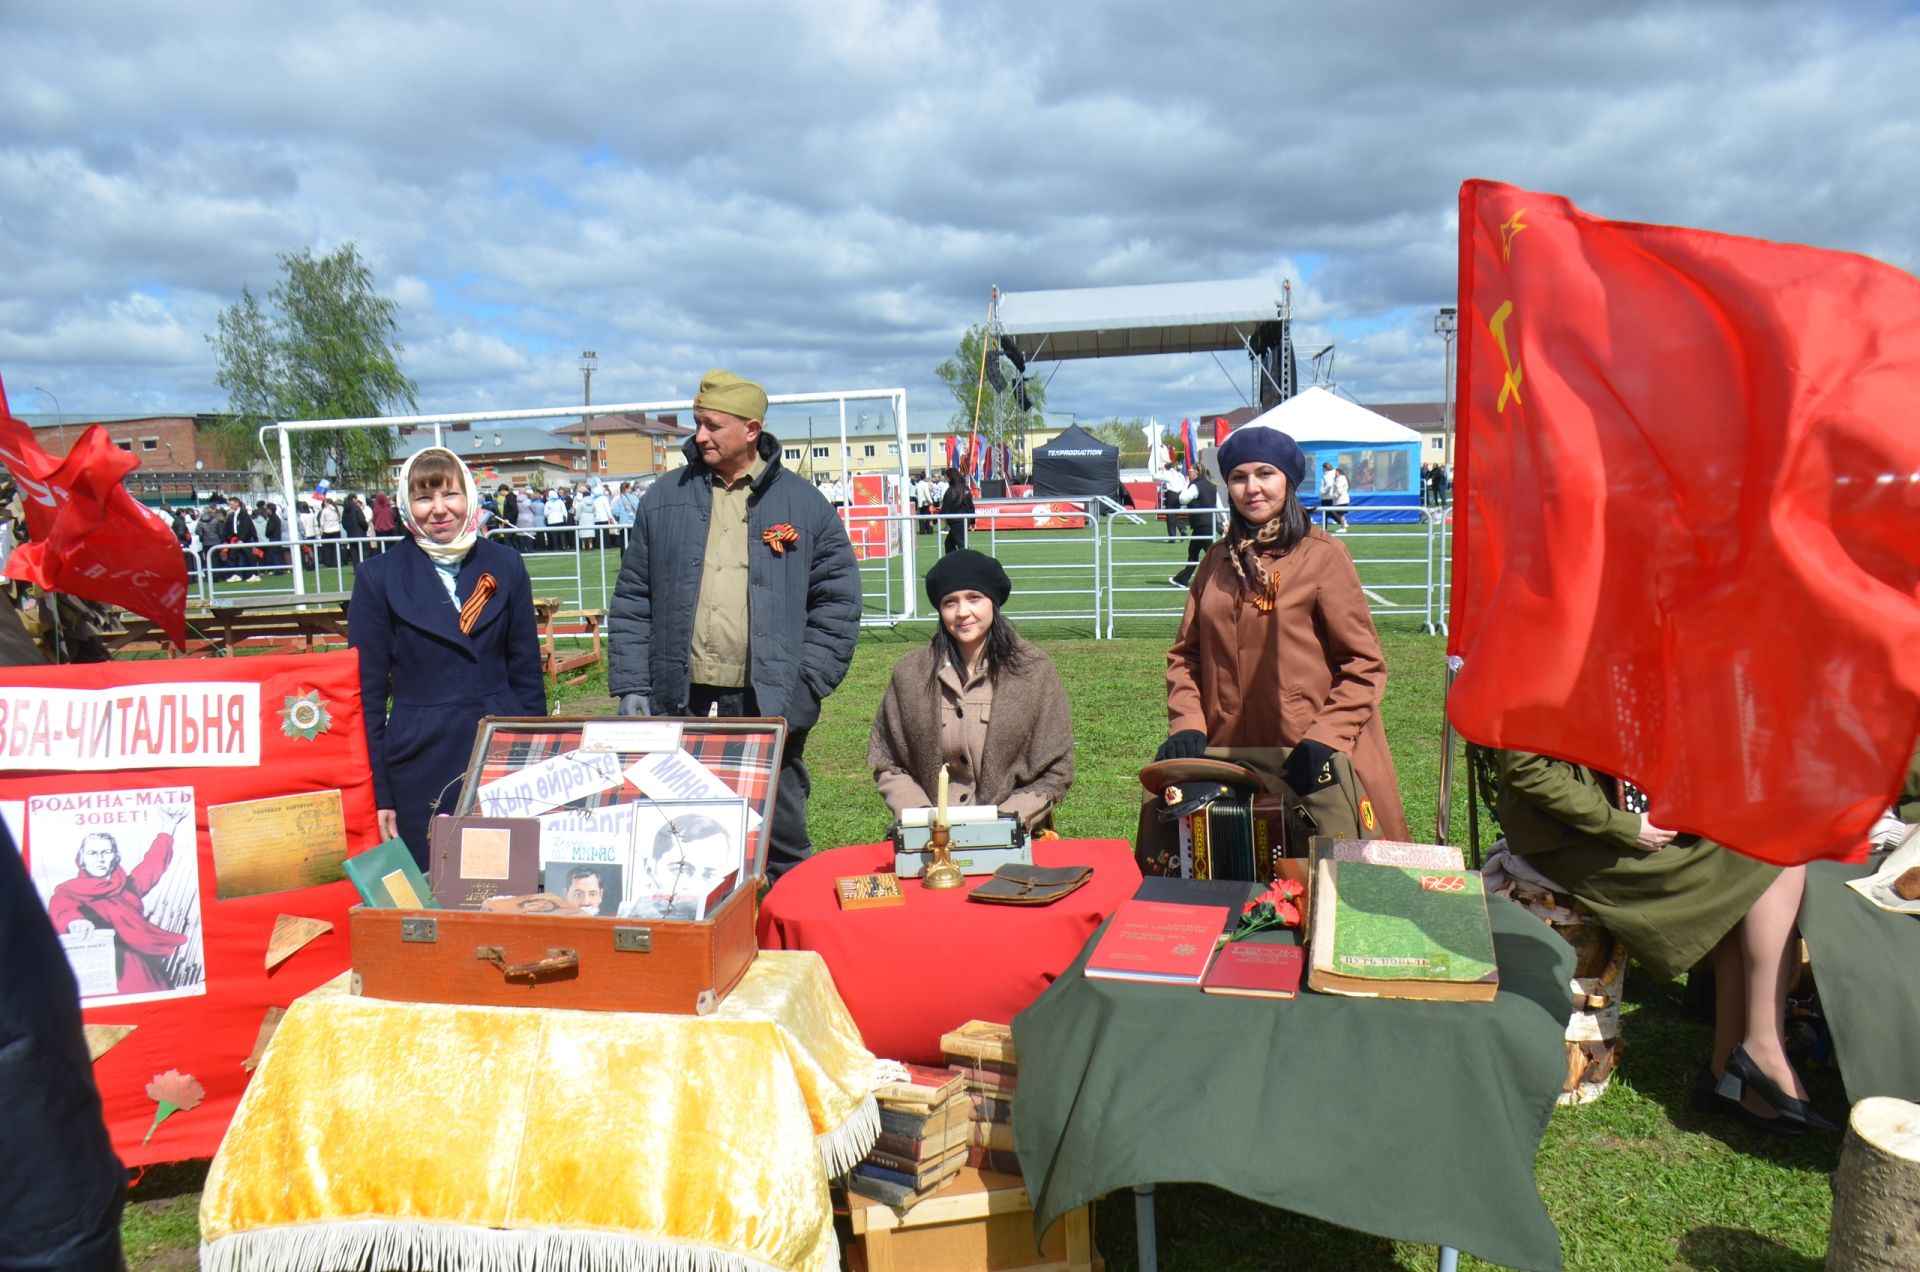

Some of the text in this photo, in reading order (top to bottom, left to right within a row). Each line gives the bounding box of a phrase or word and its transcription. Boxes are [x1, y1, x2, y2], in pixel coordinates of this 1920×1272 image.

[30, 790, 192, 813] РОДИНА-МАТЬ
[74, 810, 148, 826] ЗОВЕТ!
[571, 846, 616, 861] МИРАС
[1421, 875, 1465, 890] 1966
